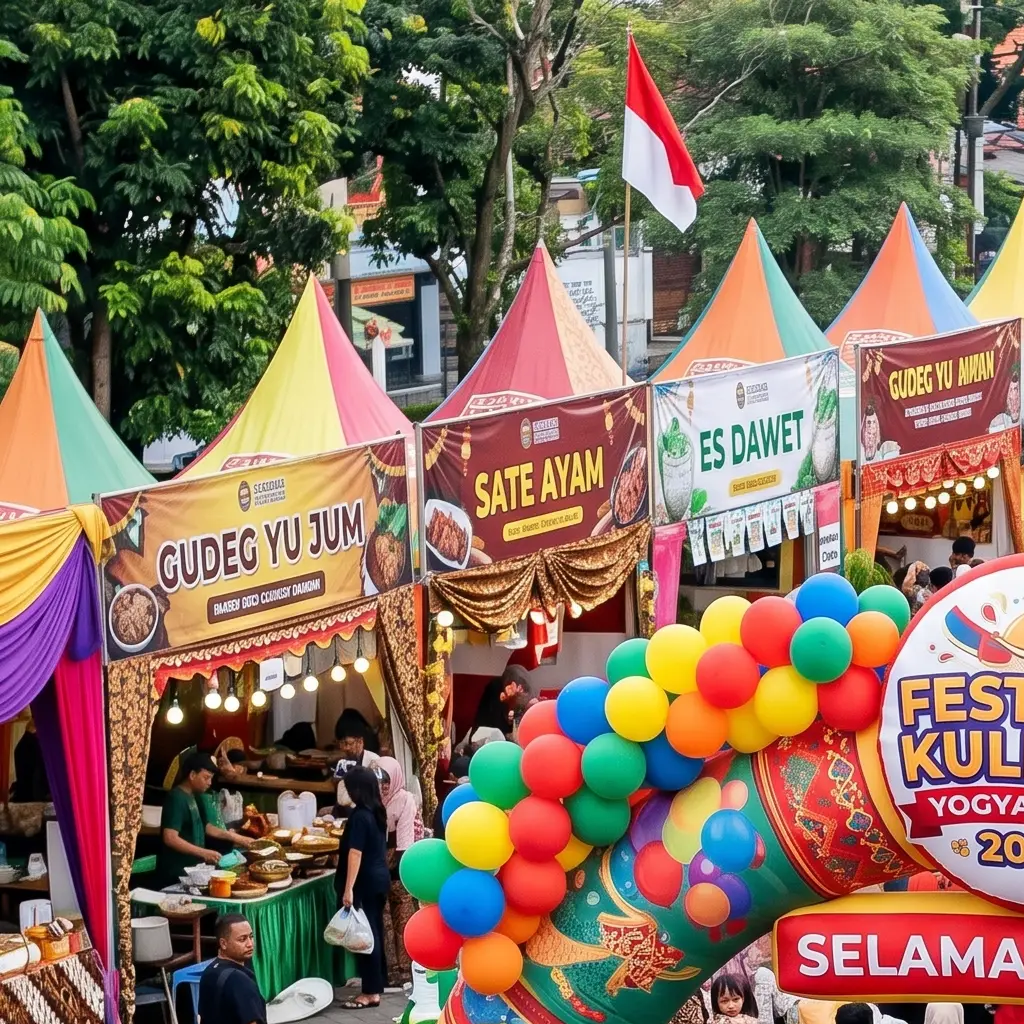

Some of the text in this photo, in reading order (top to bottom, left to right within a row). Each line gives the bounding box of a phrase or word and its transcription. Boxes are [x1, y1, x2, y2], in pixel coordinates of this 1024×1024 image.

[888, 364, 933, 401] GUDEG
[935, 359, 953, 391] YU
[700, 410, 804, 472] ES DAWET
[475, 446, 604, 519] SATE AYAM
[158, 500, 365, 589] GUDEG YU JUM
